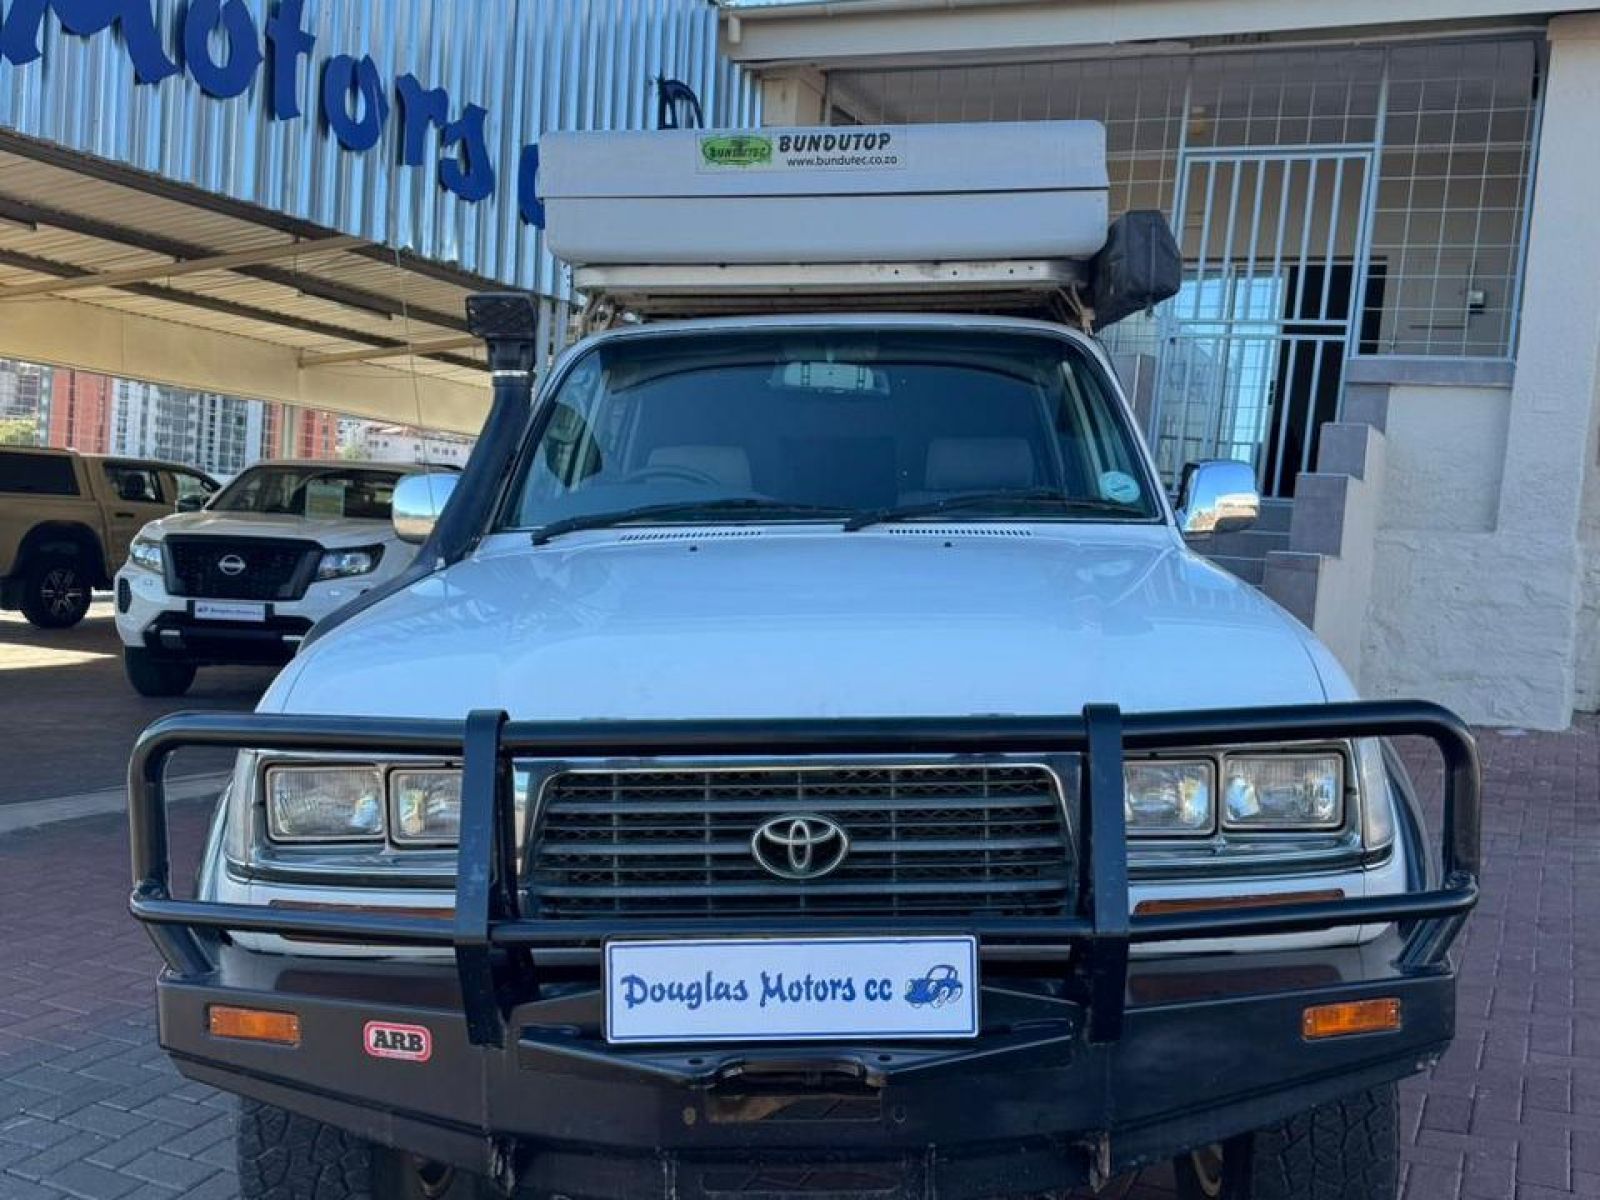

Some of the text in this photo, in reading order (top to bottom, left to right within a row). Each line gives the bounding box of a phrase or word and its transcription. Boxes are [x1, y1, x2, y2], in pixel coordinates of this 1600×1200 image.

[779, 132, 892, 154] BUNDUTOP
[786, 154, 898, 167] www.bundutec.co.za
[620, 970, 893, 1010] Douglas Motors cc
[373, 1029, 425, 1053] ARB
